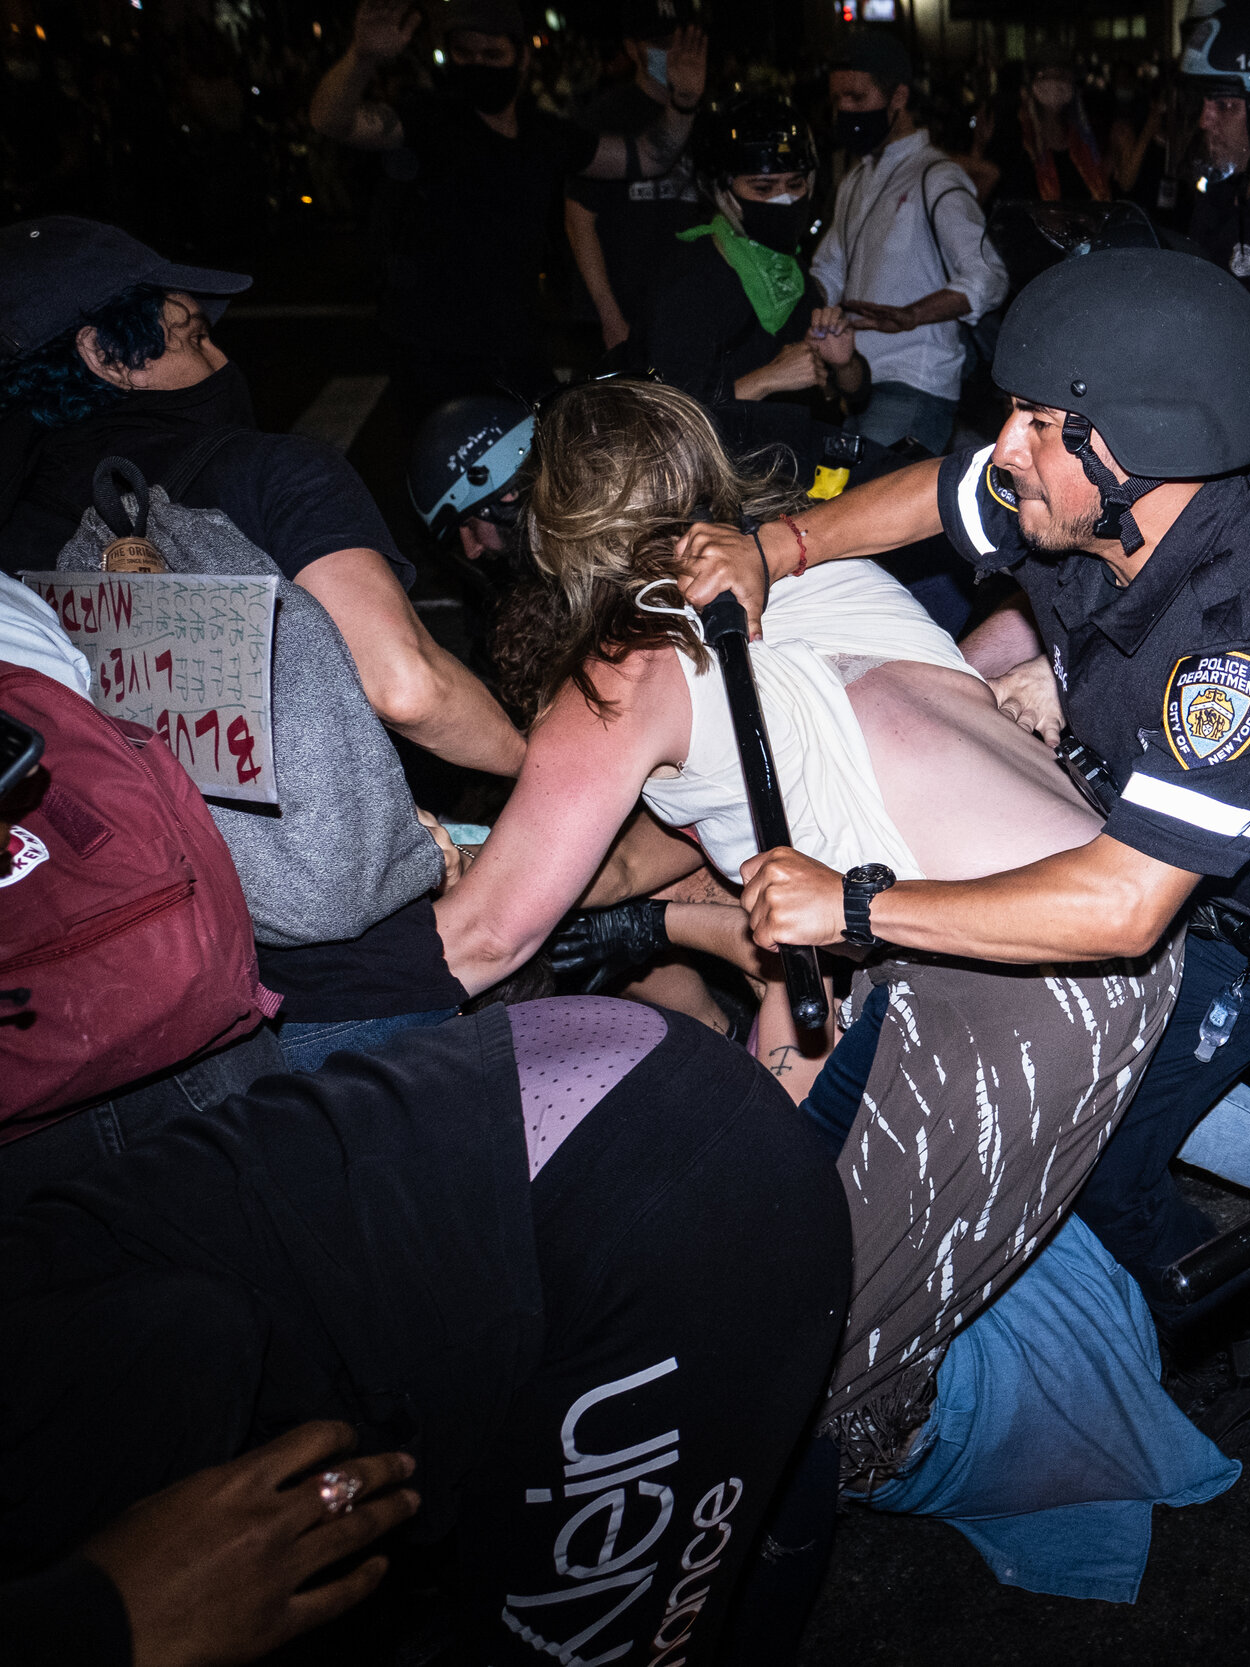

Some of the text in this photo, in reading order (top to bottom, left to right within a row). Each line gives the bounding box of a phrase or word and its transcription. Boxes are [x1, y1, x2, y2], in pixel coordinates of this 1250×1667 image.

[111, 547, 126, 559] THE
[38, 577, 132, 634] MURDE
[156, 580, 171, 633] ACAB
[189, 580, 206, 644] ACAB
[172, 582, 188, 702] ACAB FTP
[208, 581, 227, 697] ACAB FTP
[227, 581, 248, 701] ACAB FTP
[100, 647, 173, 703] LIVES
[1198, 658, 1248, 678] POLICE
[1169, 701, 1191, 755] CITY OF
[1208, 741, 1236, 766] NEW
